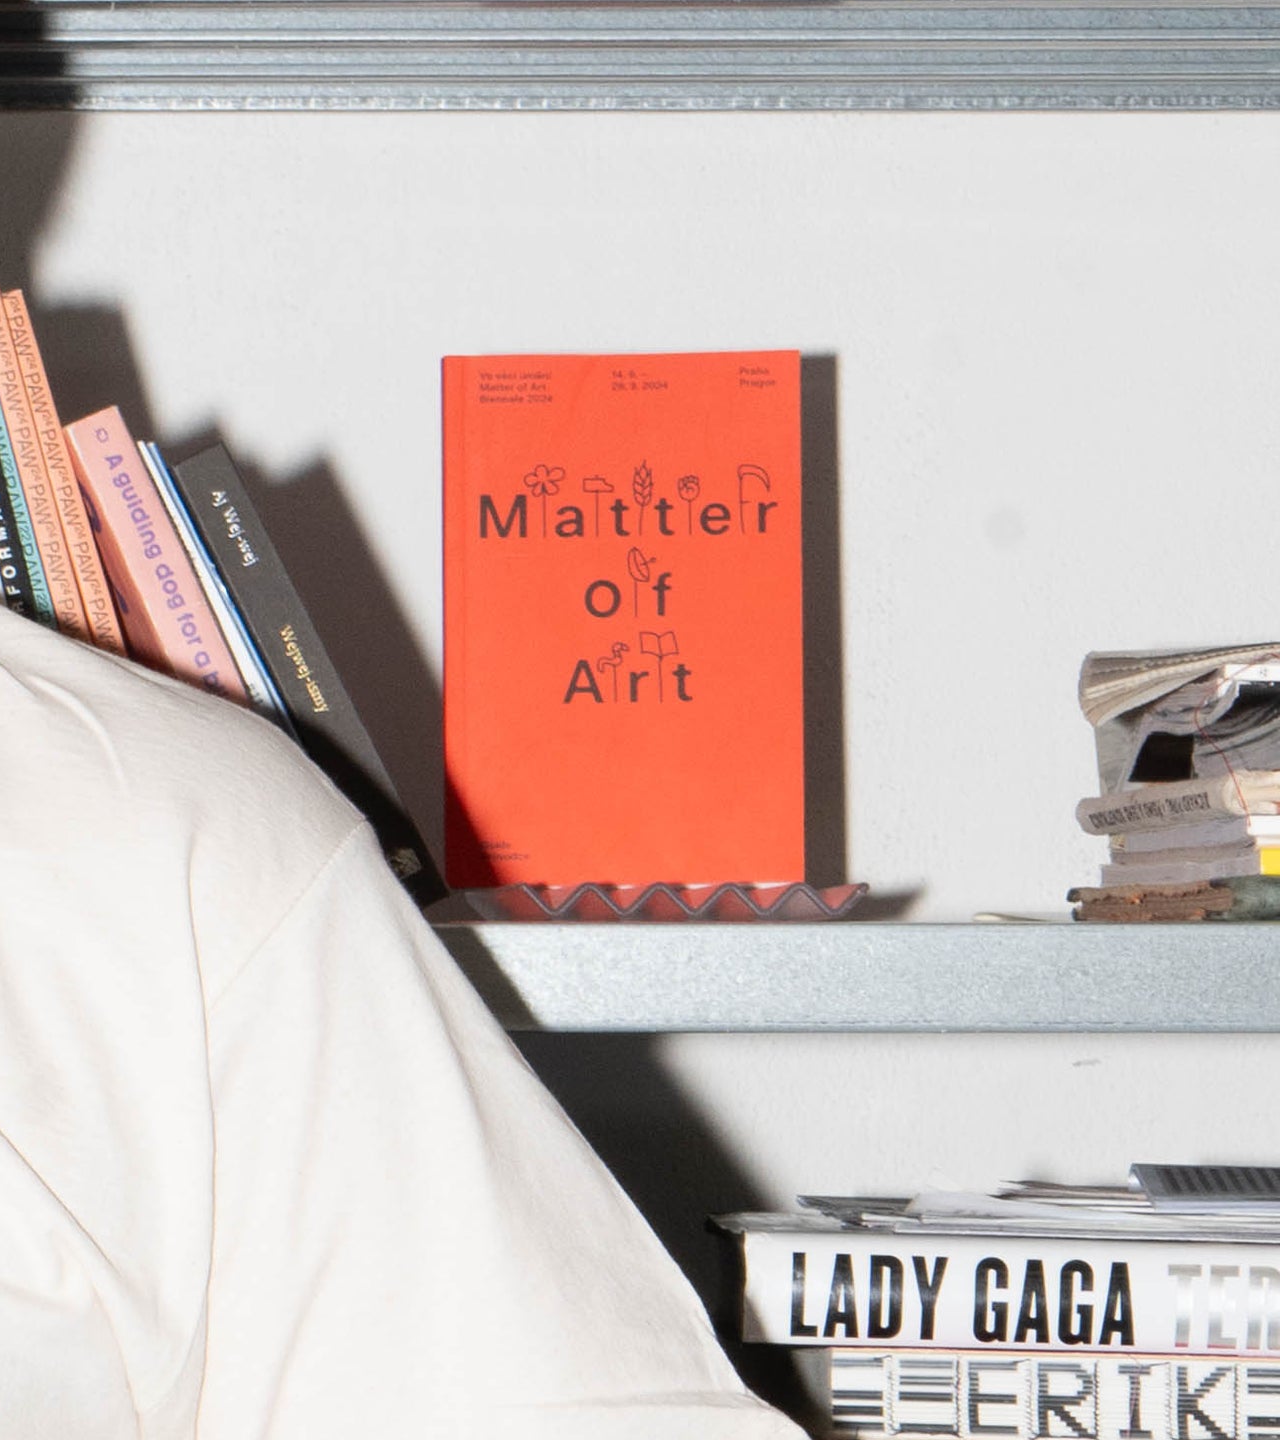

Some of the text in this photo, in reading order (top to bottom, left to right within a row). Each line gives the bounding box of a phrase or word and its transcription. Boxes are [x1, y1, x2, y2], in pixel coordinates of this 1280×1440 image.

[479, 491, 778, 539] Matter
[104, 454, 204, 647] A guiding dog for
[584, 569, 672, 619] of
[563, 656, 693, 705] Art
[790, 1251, 1135, 1347] LADY GAGA
